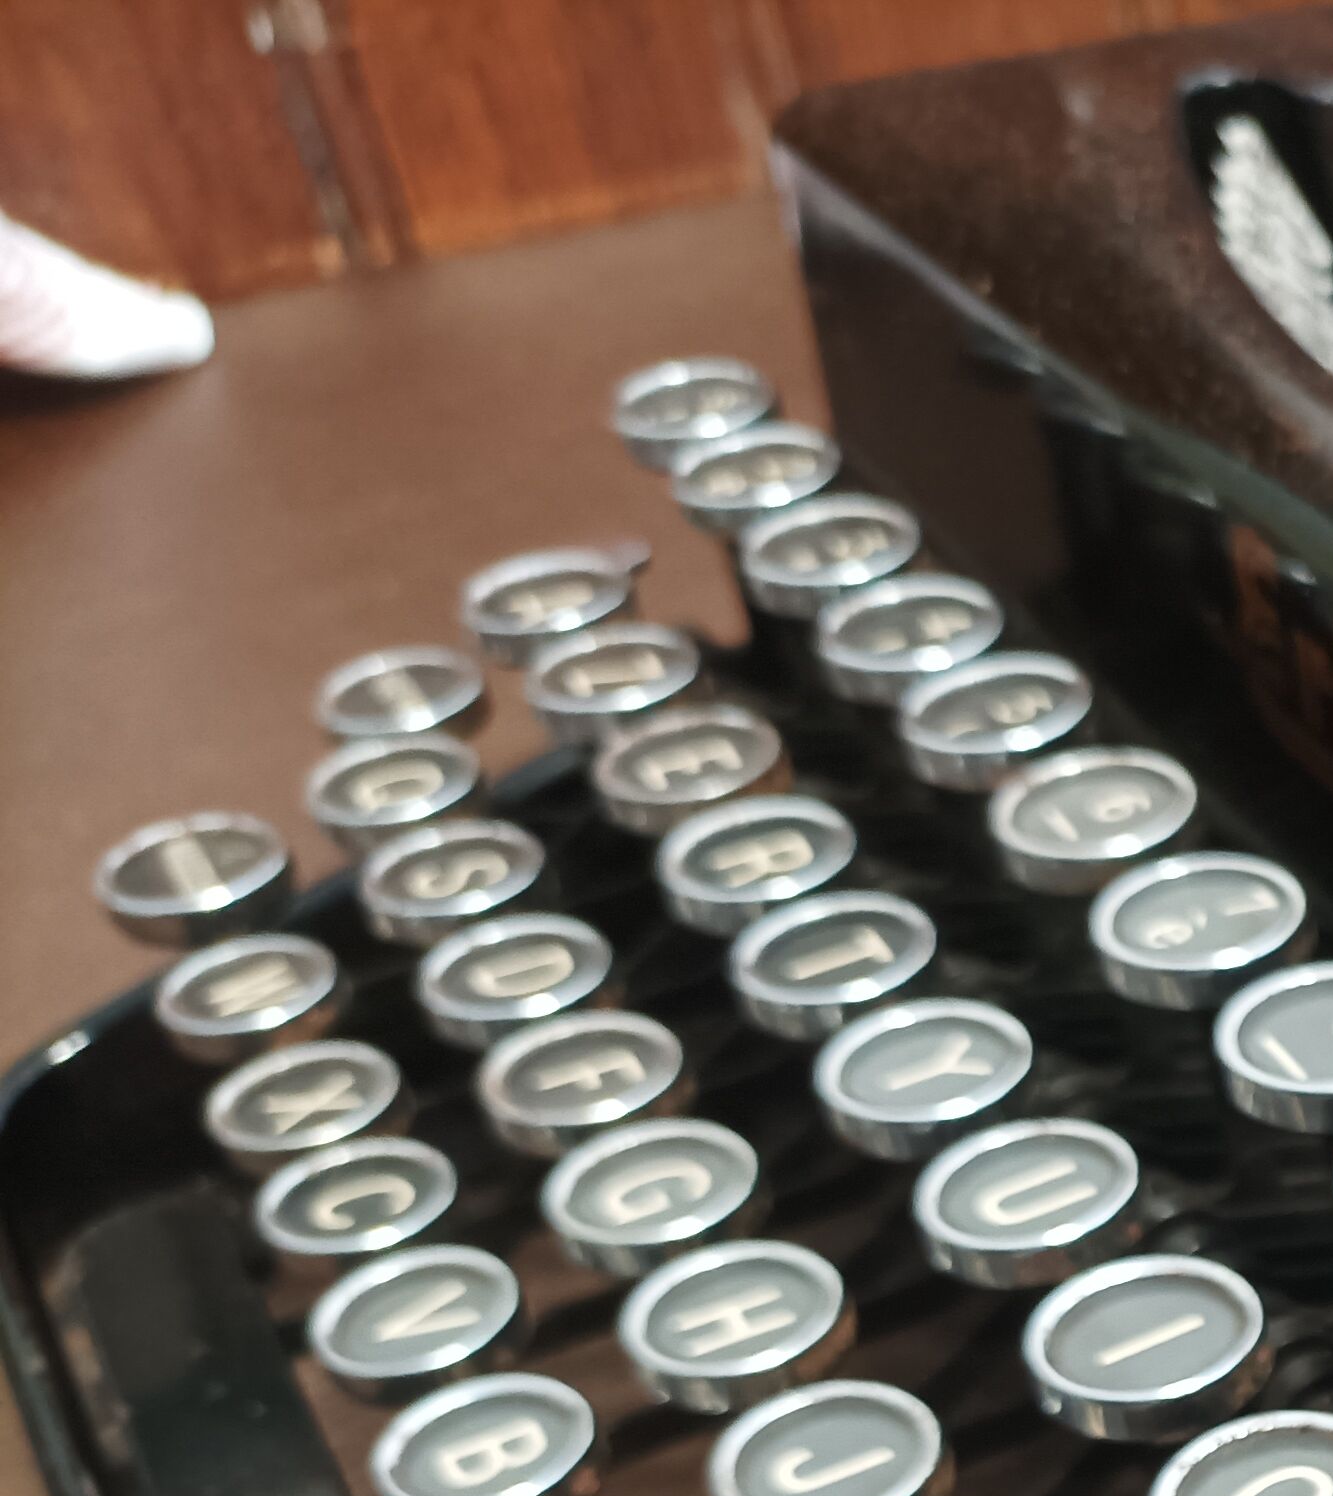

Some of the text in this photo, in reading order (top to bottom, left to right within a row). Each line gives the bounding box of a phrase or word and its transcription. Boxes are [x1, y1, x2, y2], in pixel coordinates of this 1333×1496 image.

[639, 736, 743, 791] E
[406, 848, 510, 899] S
[711, 827, 814, 889] R
[466, 942, 574, 999] D
[785, 925, 894, 981] T
[533, 1047, 648, 1091] F
[885, 1035, 993, 1091] Y
[264, 1070, 364, 1134] X
[307, 1173, 416, 1231] C
[608, 1158, 712, 1225] G
[973, 1158, 1098, 1226] U
[375, 1279, 481, 1343] V
[674, 1286, 796, 1356] H
[437, 1418, 548, 1489] B
[775, 1445, 896, 1494] J
